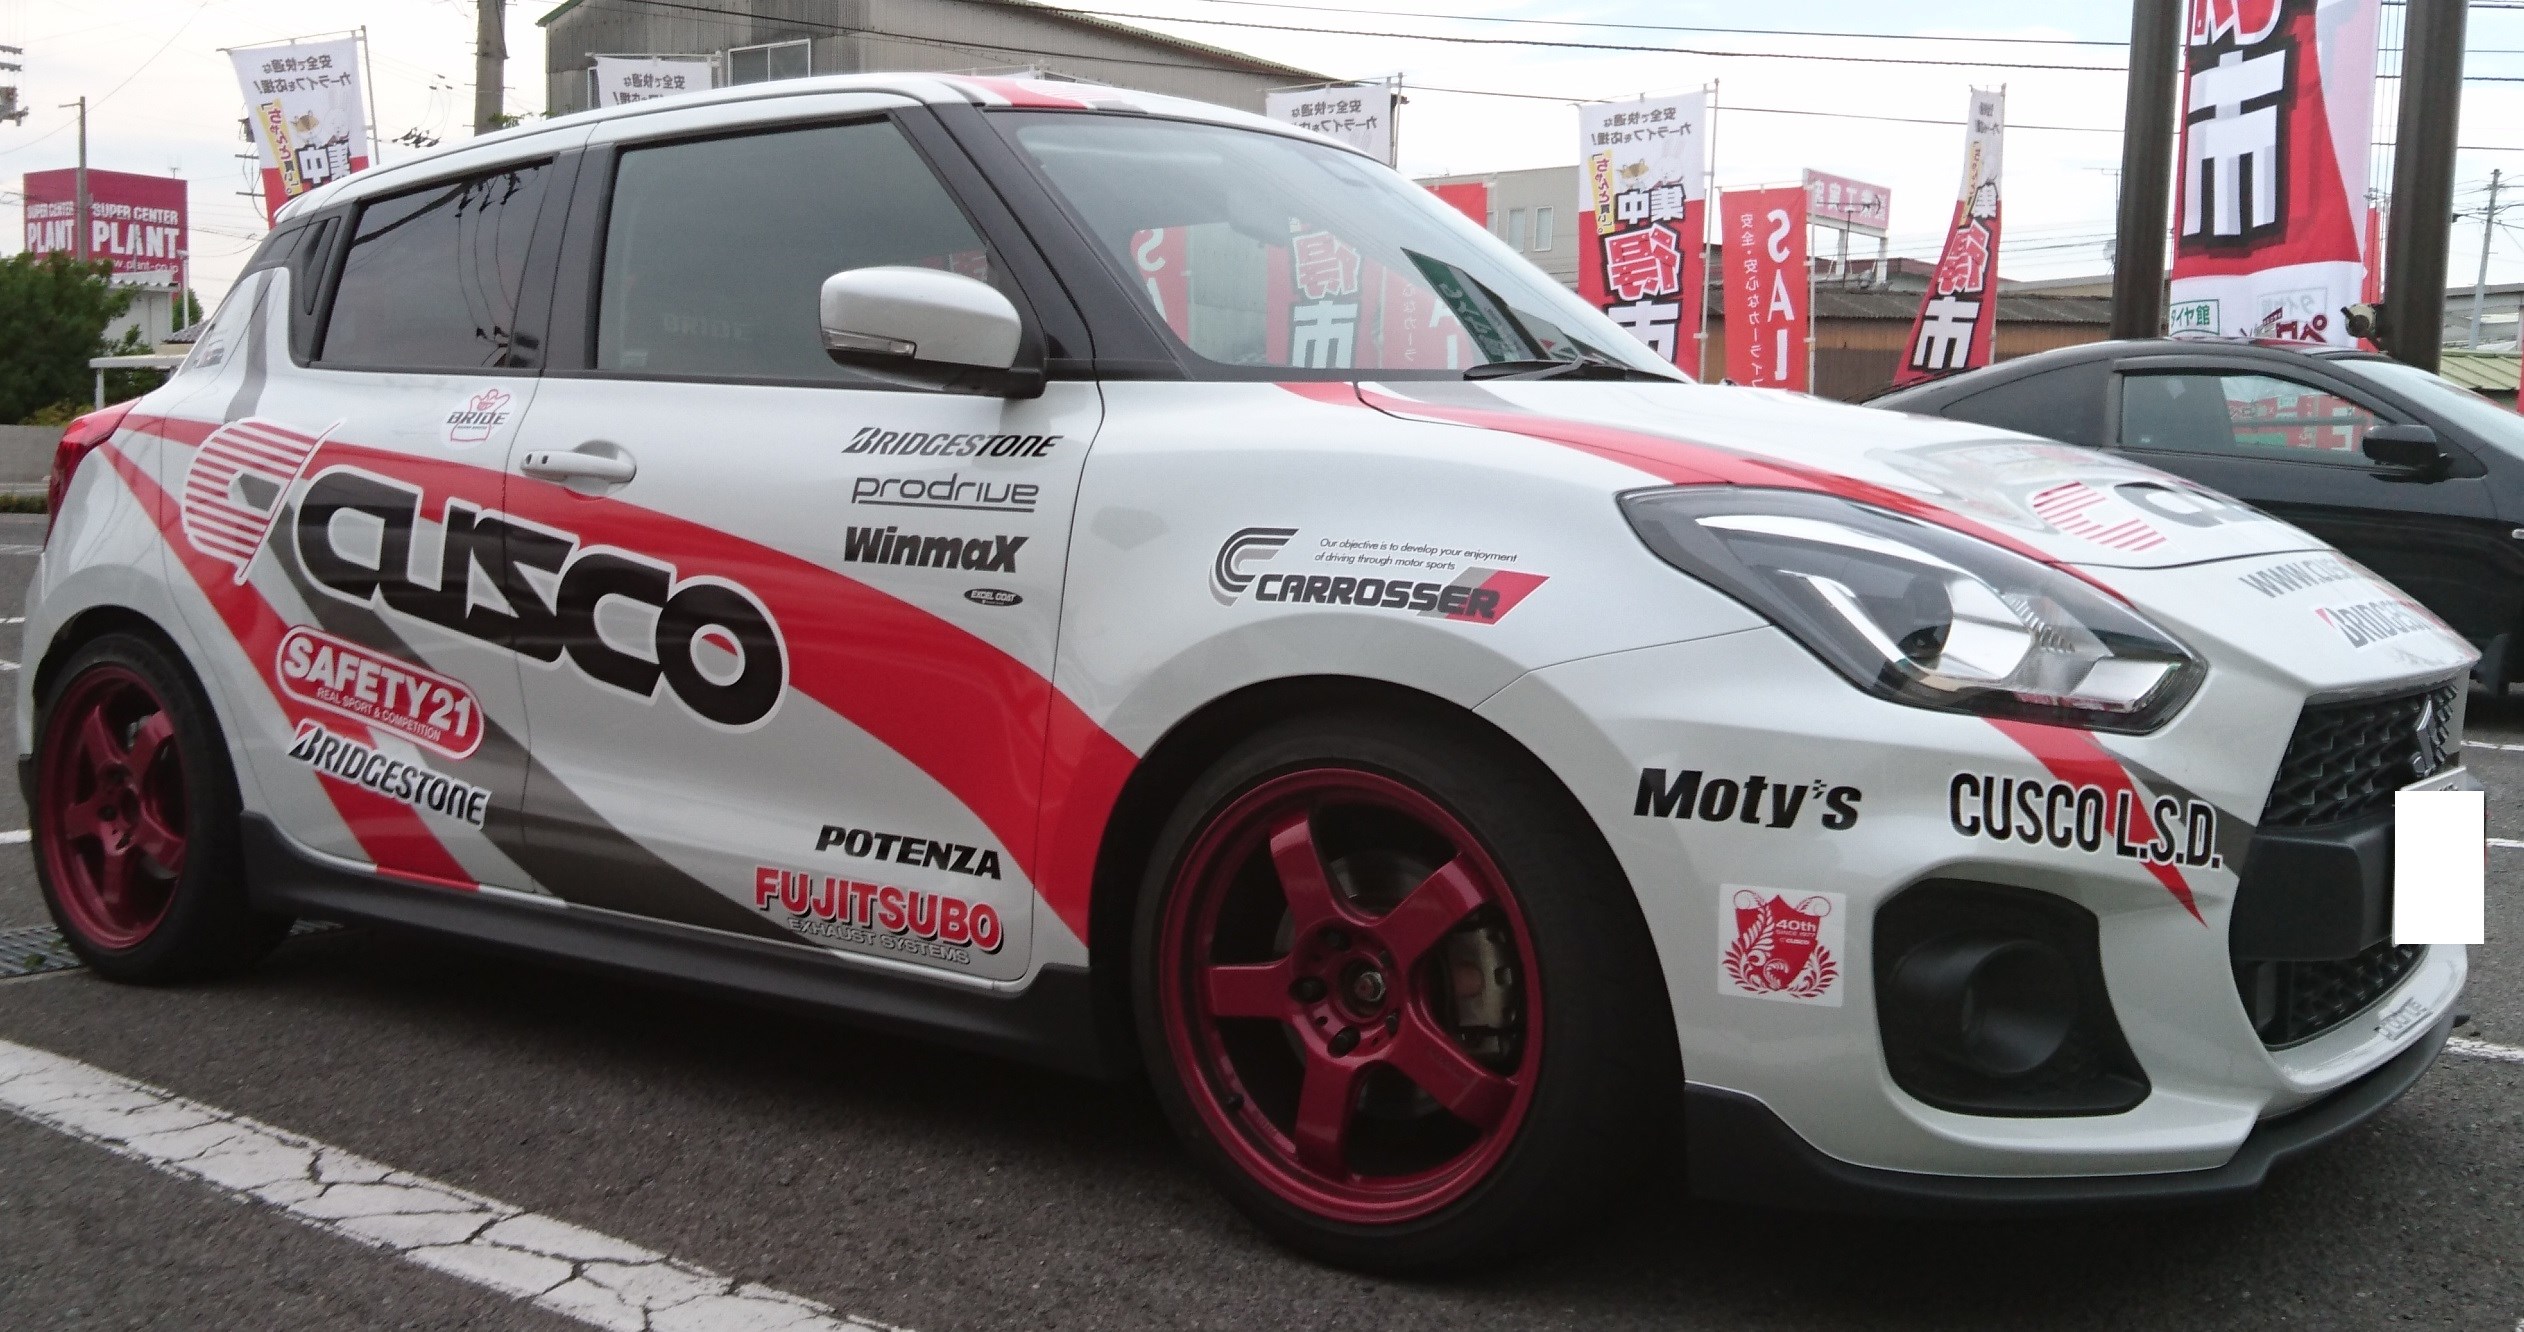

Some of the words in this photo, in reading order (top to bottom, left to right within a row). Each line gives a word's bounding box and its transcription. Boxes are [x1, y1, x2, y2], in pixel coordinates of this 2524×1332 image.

[91, 202, 132, 220] SUPER
[133, 206, 179, 225] CENTER
[27, 219, 75, 253] PLANT
[92, 220, 180, 259] PLANT
[446, 411, 510, 425] BRIDE
[841, 427, 1064, 457] BRIDGESTONE
[851, 472, 1040, 505] prodrive
[1314, 552, 1327, 562] of
[1326, 552, 1356, 565] driving
[1357, 553, 1393, 566] through
[1394, 555, 1424, 568] motor
[1425, 560, 1455, 570] sports
[1320, 538, 1338, 548] Our
[1339, 539, 1378, 551] objective
[1380, 541, 1388, 551] is
[1389, 542, 1399, 552] to
[1400, 542, 1438, 556] develop
[1438, 547, 1462, 558] your
[1464, 549, 1518, 562] enjoyment
[293, 467, 788, 732] CUSCO
[1255, 573, 1501, 620] CARROSSER
[317, 686, 342, 705] REAL
[342, 694, 373, 716] SPORT
[374, 706, 381, 719] &
[382, 708, 442, 742] COMPETITION
[288, 726, 487, 826] BRIDGESTONE
[1633, 767, 1863, 831] Moty's
[1950, 772, 2106, 853] CUSCO
[2116, 792, 2221, 869] L.S.D.
[815, 824, 1002, 880] POTENZA
[755, 867, 1004, 952] FUJITSUBO
[1775, 919, 1817, 932] 40th
[787, 918, 877, 946] EXHAUST
[880, 934, 970, 964] SYSTEMS
